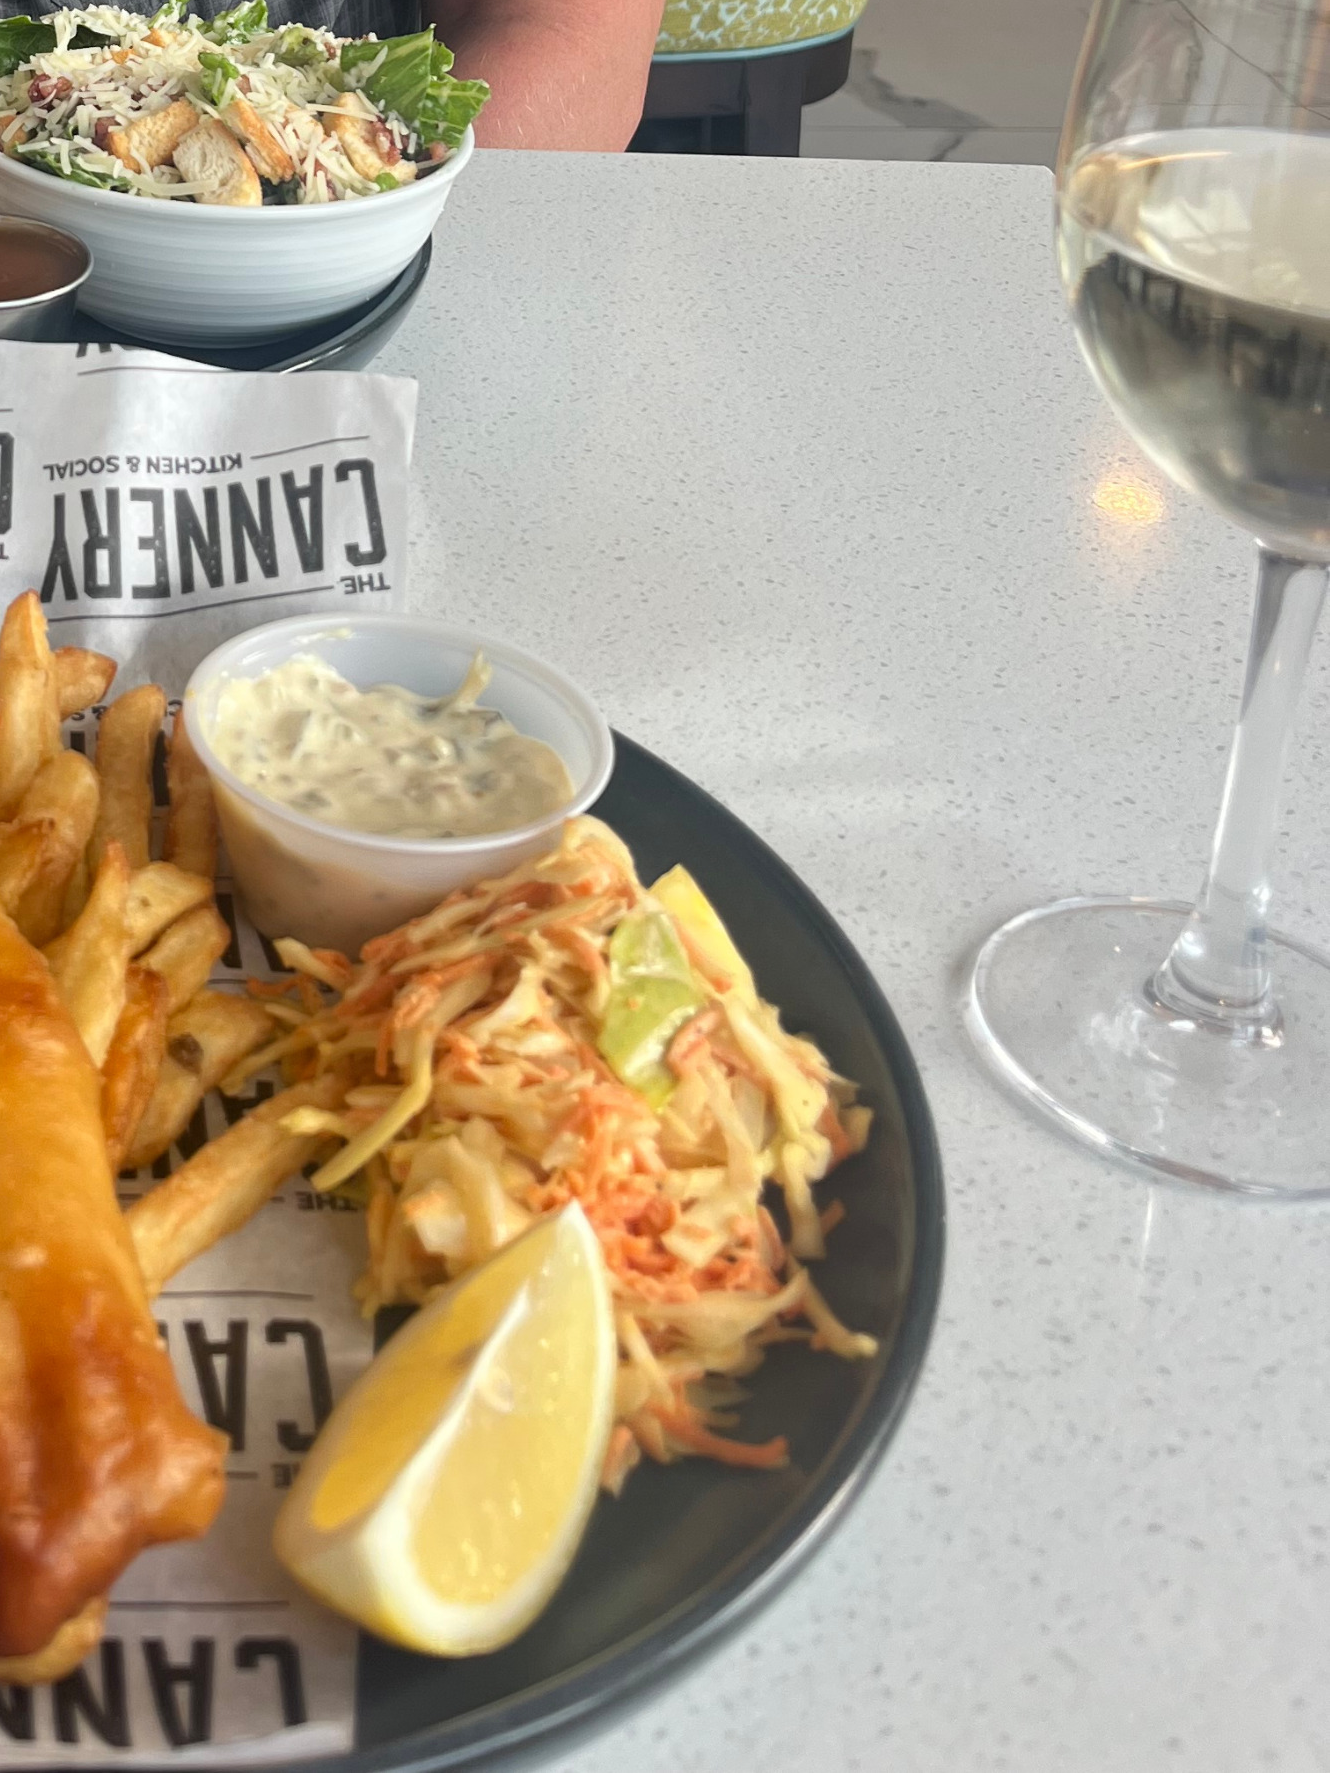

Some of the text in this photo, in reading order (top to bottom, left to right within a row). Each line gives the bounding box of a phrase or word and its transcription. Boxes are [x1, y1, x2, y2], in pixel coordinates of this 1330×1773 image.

[42, 452, 243, 481] KITCHEN & SOCIAL
[39, 457, 388, 604] CANNERY
[339, 571, 391, 595] THE
